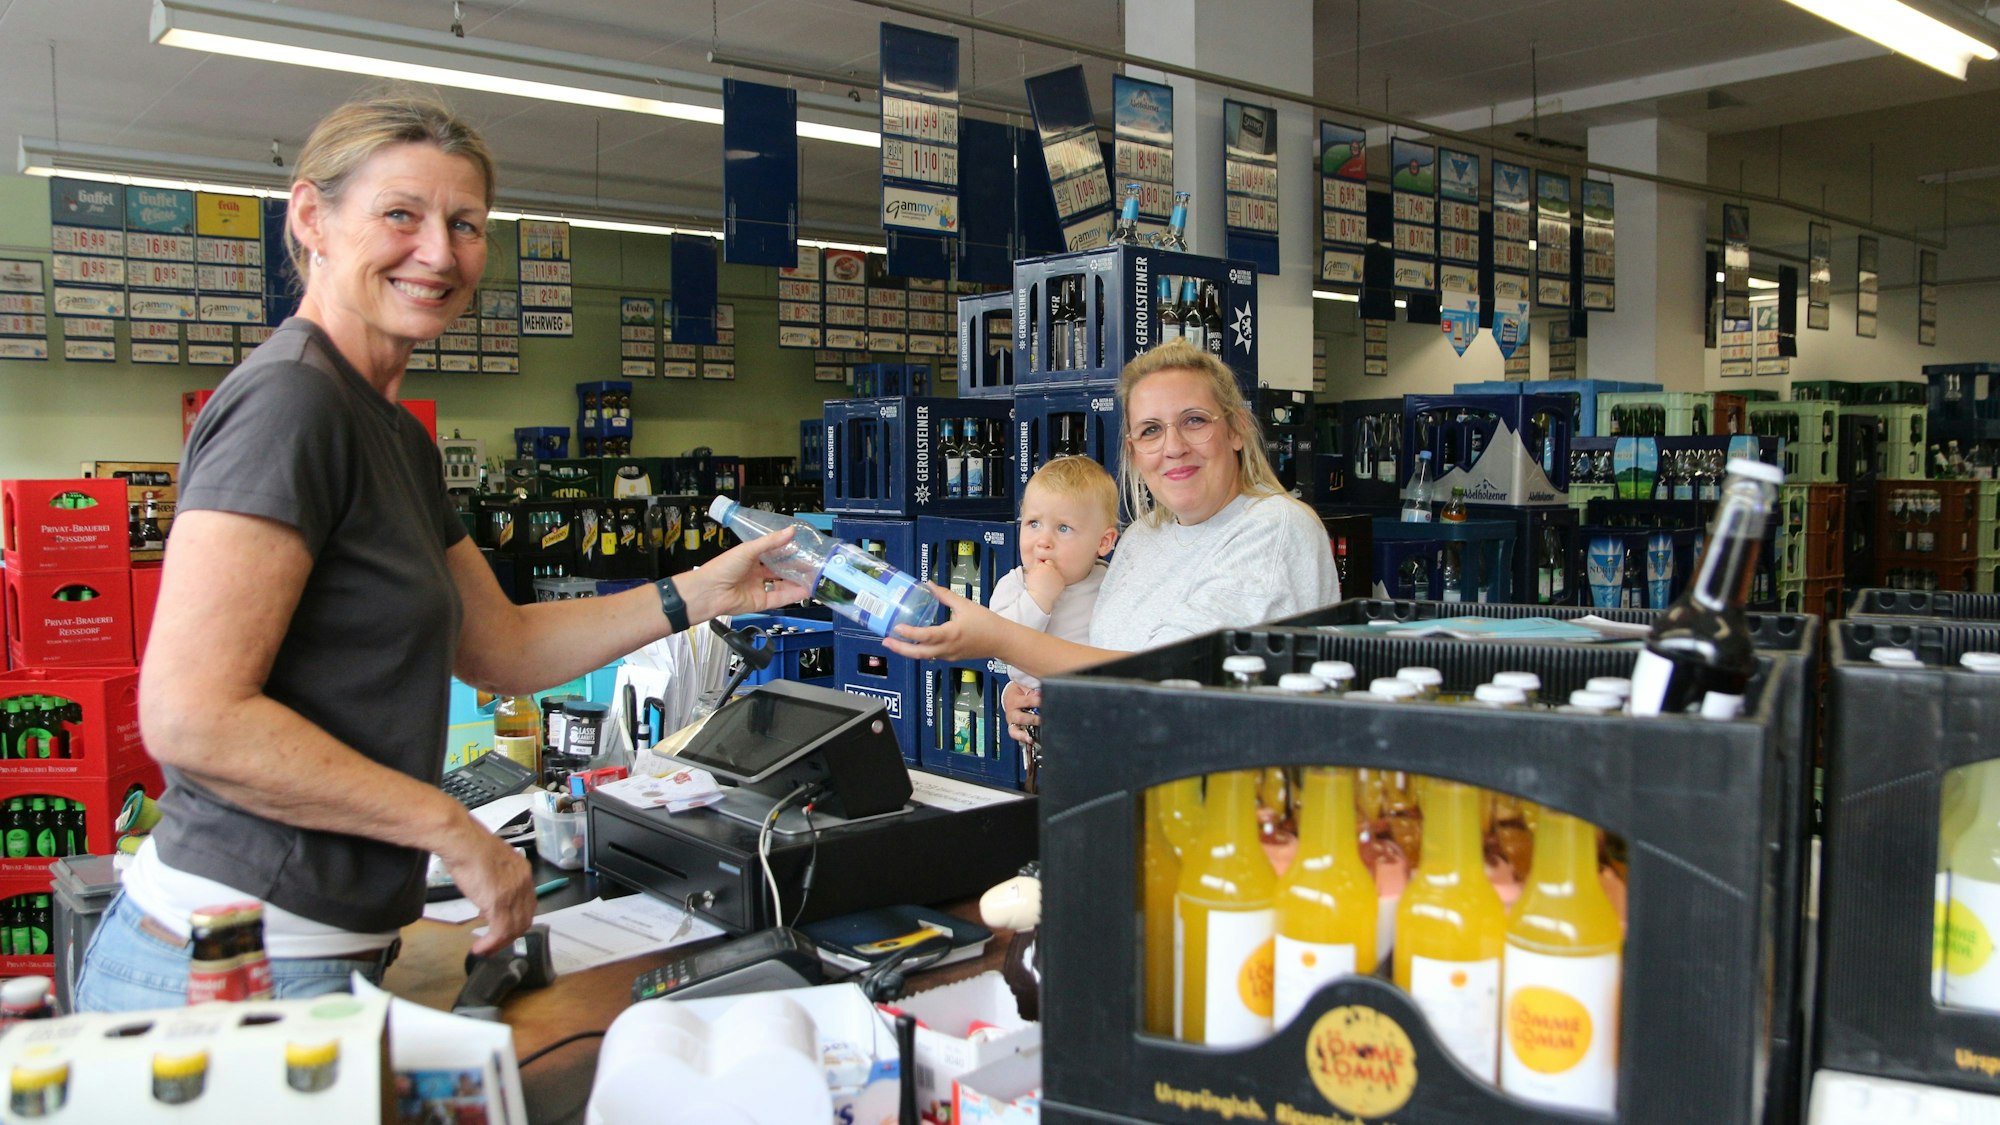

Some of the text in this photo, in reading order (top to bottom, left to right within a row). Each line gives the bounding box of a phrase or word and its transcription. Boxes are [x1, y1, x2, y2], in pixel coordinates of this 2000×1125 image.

[914, 150, 937, 174] 1.10
[1138, 150, 1157, 170] 8.49
[1248, 203, 1264, 223] 1.00
[73, 231, 105, 249] 16.99
[146, 238, 177, 255] 16.99
[82, 261, 105, 277] 0.95
[154, 267, 177, 283] 0.95
[1136, 256, 1148, 345] GEROLSTEINER
[1019, 288, 1027, 339] GEROLSTEINER
[524, 315, 563, 332] MEHRWEG
[917, 405, 929, 482] GEROLSTEINER
[1020, 421, 1028, 472] GEROLSTEINER
[1464, 489, 1507, 501] Adelholzener
[41, 524, 110, 534] PRIVAT-BRAUEREI
[45, 617, 113, 627] PRIVAT-BRAUEREI
[59, 627, 100, 636] REISSDORF
[579, 727, 596, 735] LASSE
